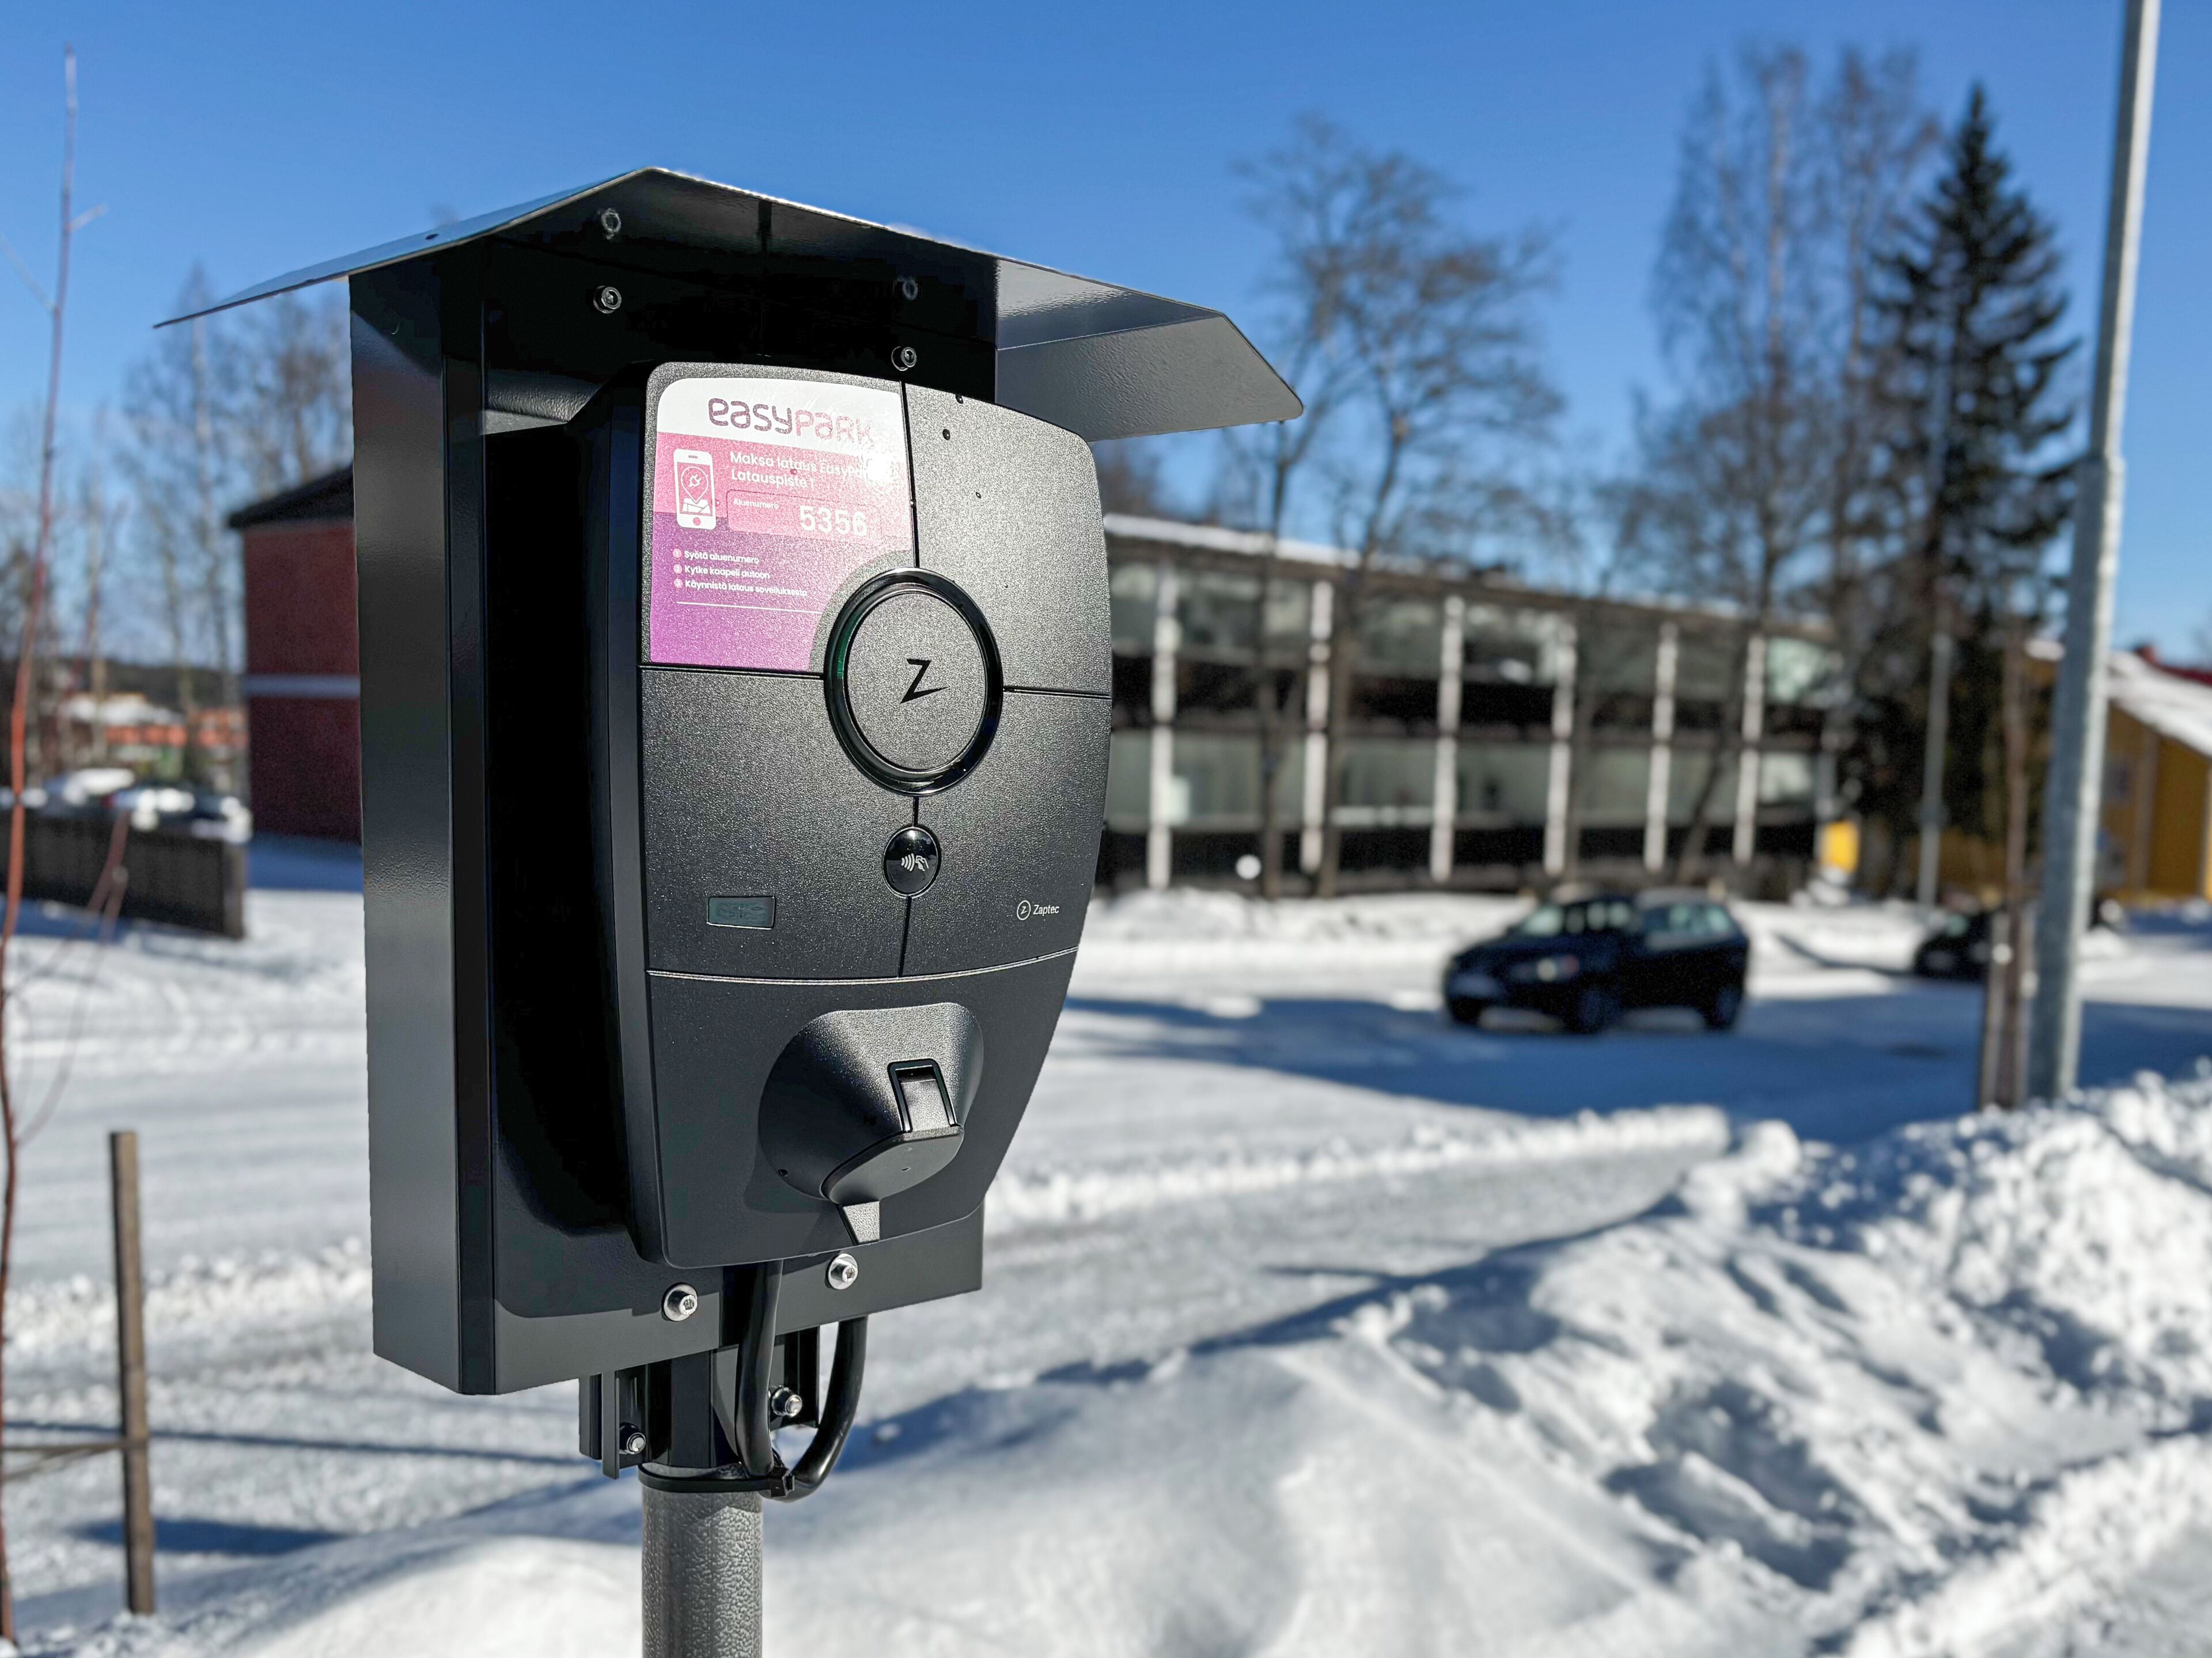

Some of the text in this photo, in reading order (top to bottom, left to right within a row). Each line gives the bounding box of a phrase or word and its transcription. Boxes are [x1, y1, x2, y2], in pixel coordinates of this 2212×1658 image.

[730, 451, 774, 467] Maksa
[778, 456, 817, 472] lataus
[731, 468, 806, 488] Latauspiste
[733, 498, 779, 509] Aluenumero
[799, 505, 868, 538] 5356
[684, 550, 709, 561] Syötä
[709, 553, 760, 564] aluenumero
[684, 565, 709, 576] Kytke
[710, 566, 740, 578] kaapeli
[741, 570, 770, 579] autoon
[685, 579, 728, 591] Käynnistä
[728, 582, 754, 592] lataus
[1033, 904, 1060, 917] Zaptec
